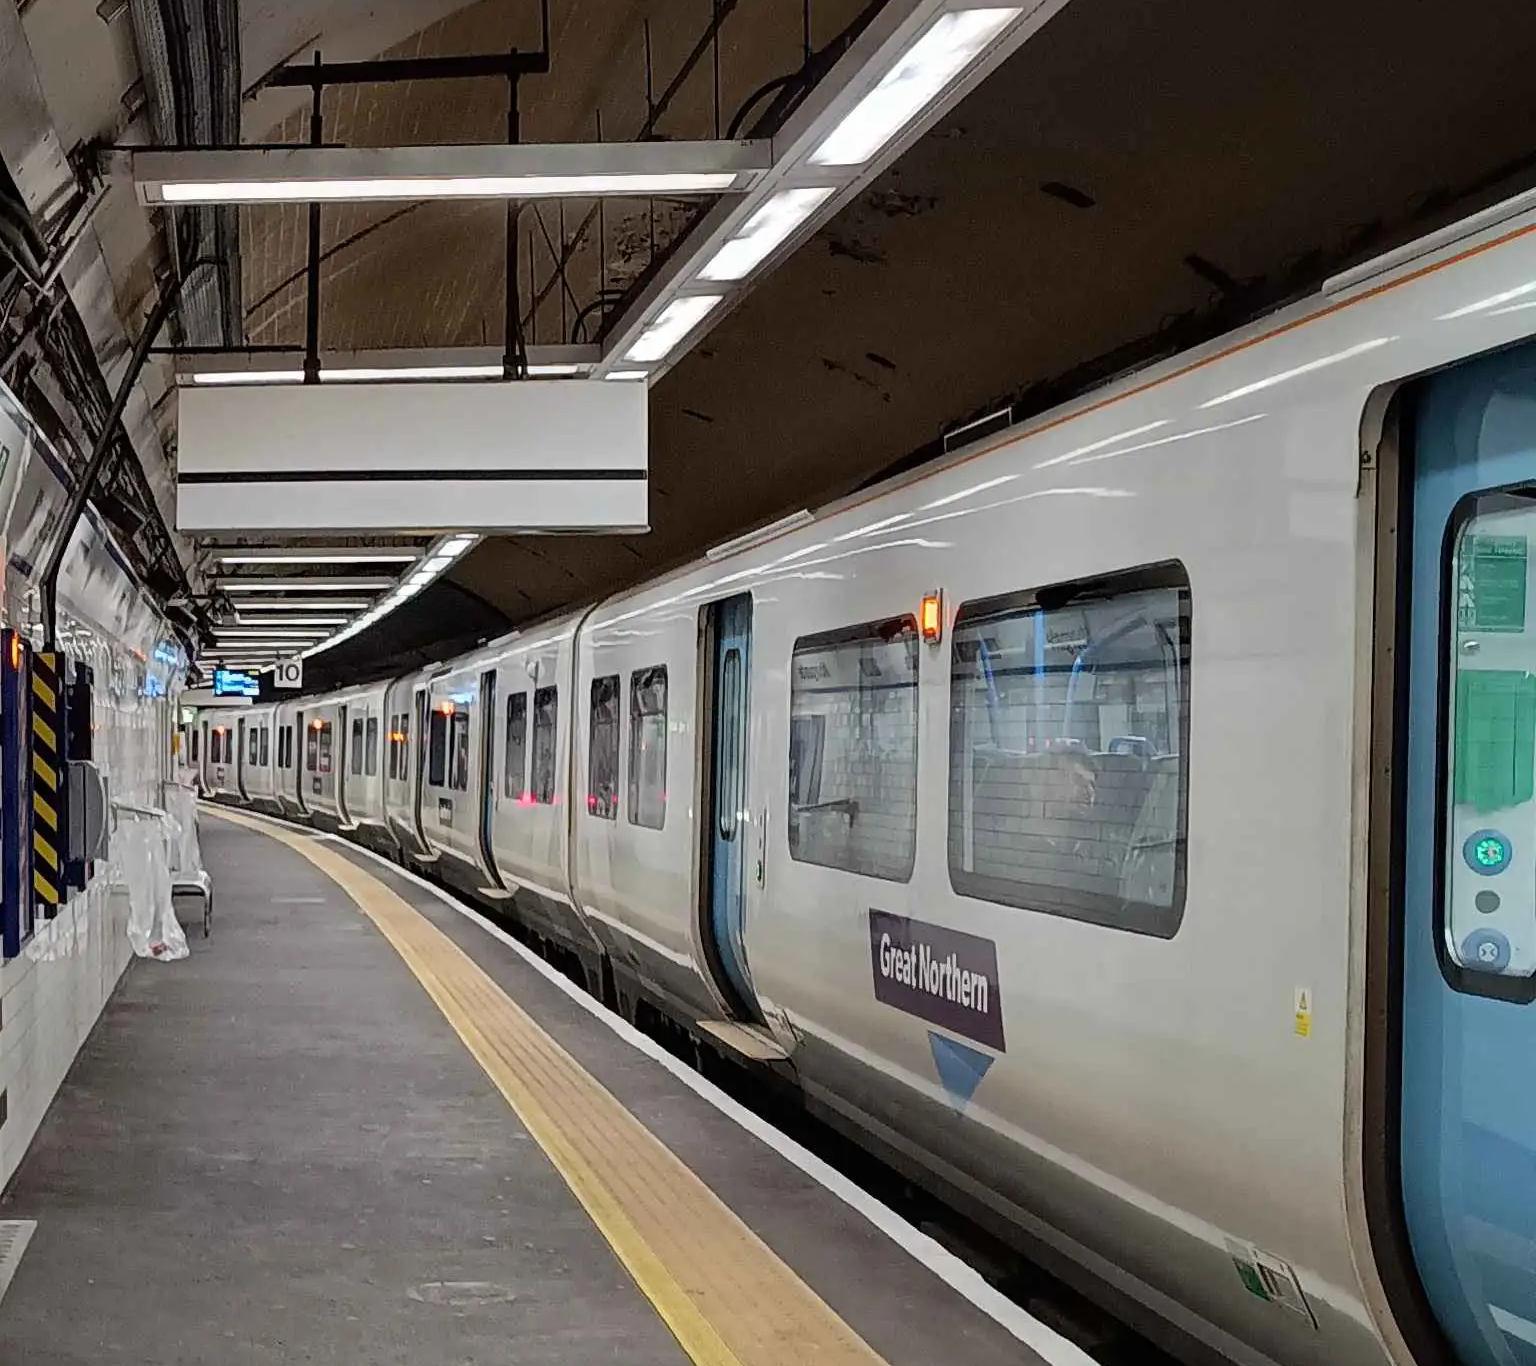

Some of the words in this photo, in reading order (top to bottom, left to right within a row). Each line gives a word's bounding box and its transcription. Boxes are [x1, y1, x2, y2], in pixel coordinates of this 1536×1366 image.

[275, 663, 300, 682] 10
[880, 932, 917, 990] Great
[918, 943, 988, 1013] Northern
